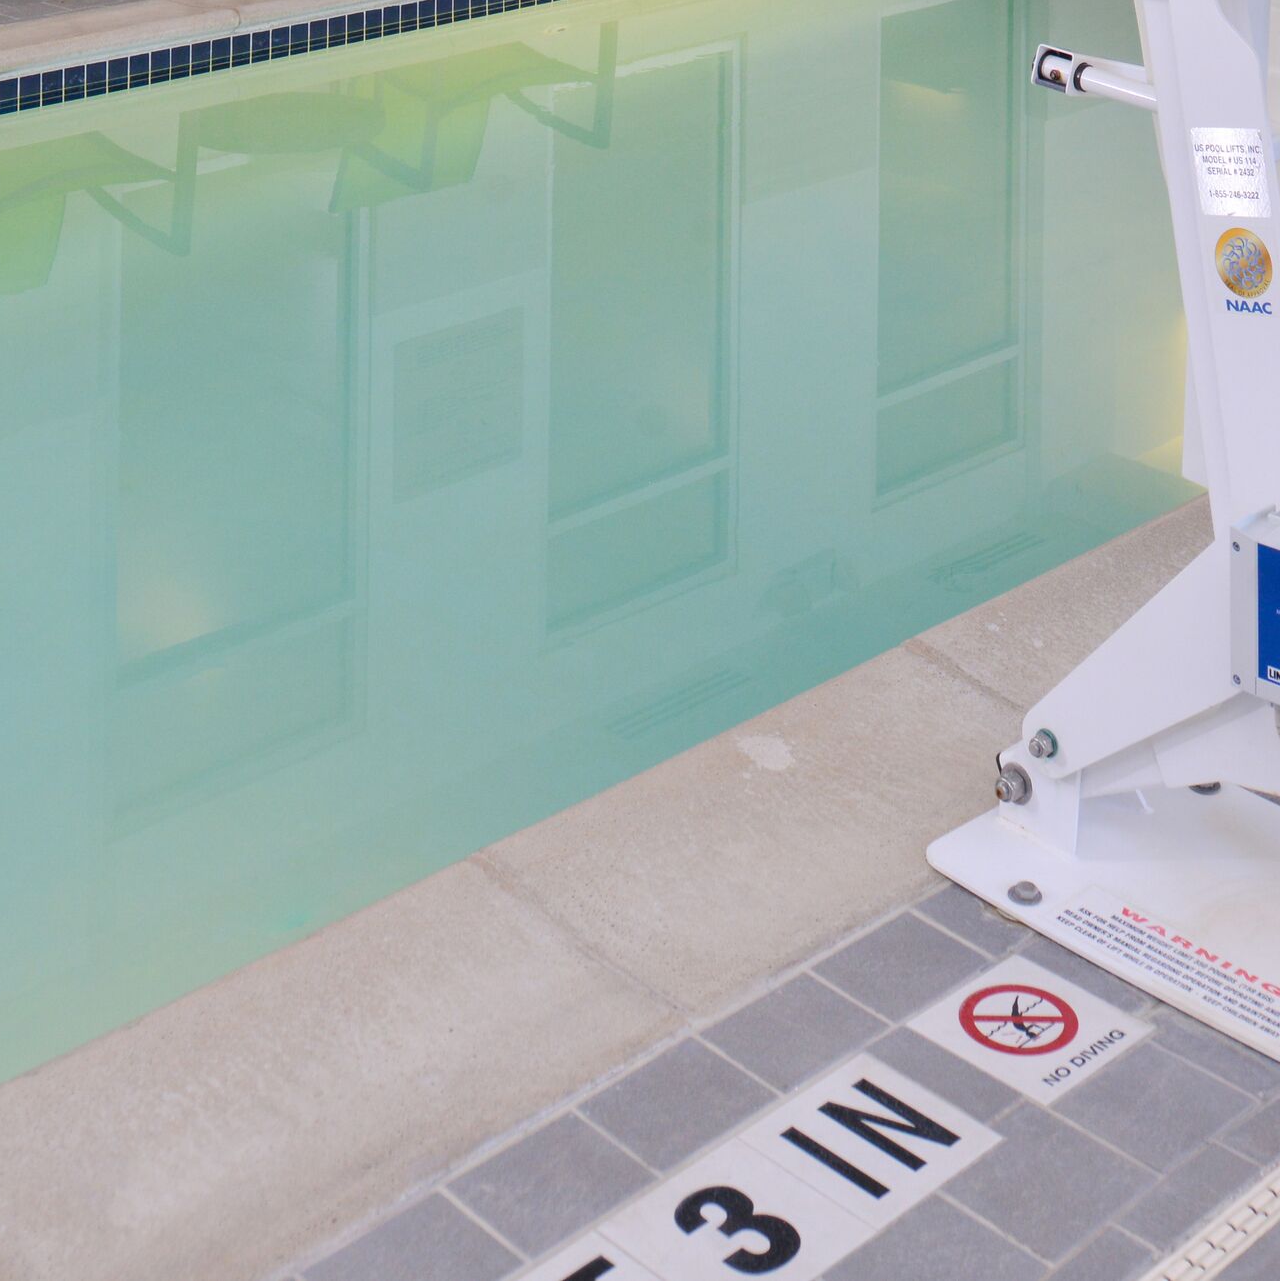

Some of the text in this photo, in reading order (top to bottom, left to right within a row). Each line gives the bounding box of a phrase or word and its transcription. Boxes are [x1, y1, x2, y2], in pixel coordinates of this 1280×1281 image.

[1202, 156, 1227, 164] MODEL
[1233, 156, 1243, 164] US
[1207, 167, 1232, 175] SERIAL
[1226, 299, 1272, 315] NAAC
[1056, 916, 1075, 926] KEEP
[1079, 908, 1092, 916] ASK
[1093, 915, 1107, 924] FOR
[1107, 923, 1125, 933] HELP
[1126, 933, 1146, 945] FROM
[1111, 915, 1146, 935] MAXIMUM
[1114, 937, 1140, 954] MANUAL
[1223, 996, 1238, 1005] AND
[1042, 1029, 1126, 1087] NO DIVING
[674, 1078, 961, 1275] 3 IN
